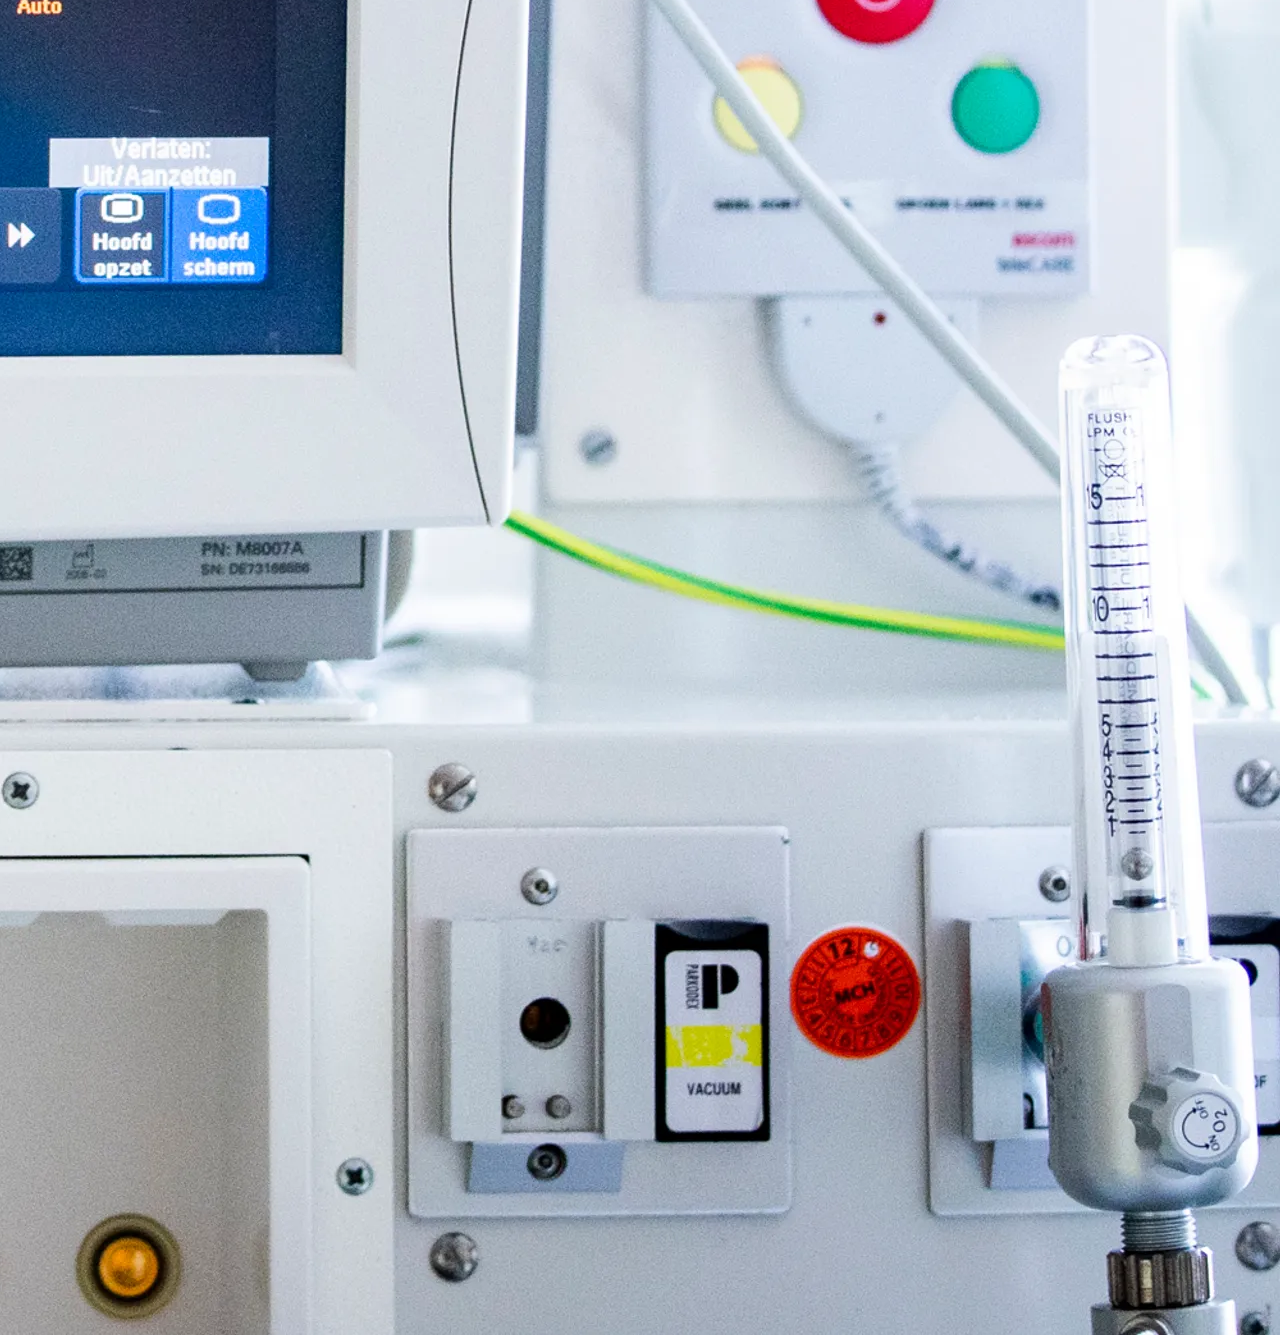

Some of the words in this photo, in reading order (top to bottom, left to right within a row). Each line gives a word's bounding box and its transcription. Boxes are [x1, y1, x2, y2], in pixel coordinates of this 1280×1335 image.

[110, 138, 212, 160] Verlaten:
[83, 164, 236, 187] Uit/Aanzetten
[92, 231, 153, 252] Hoofd
[189, 230, 250, 252] Hoofd
[93, 258, 153, 280] opzet
[183, 257, 256, 278] scherm
[200, 541, 232, 558] PN:
[1092, 595, 1110, 623] 10
[1101, 714, 1112, 738] 5
[1102, 738, 1113, 762] 4
[1103, 765, 1114, 789] 3
[1104, 790, 1115, 814] 2
[828, 937, 855, 959] 12
[834, 981, 876, 1005] MCH
[686, 1082, 743, 1097] VACUUM
[1208, 1134, 1221, 1152] ON
